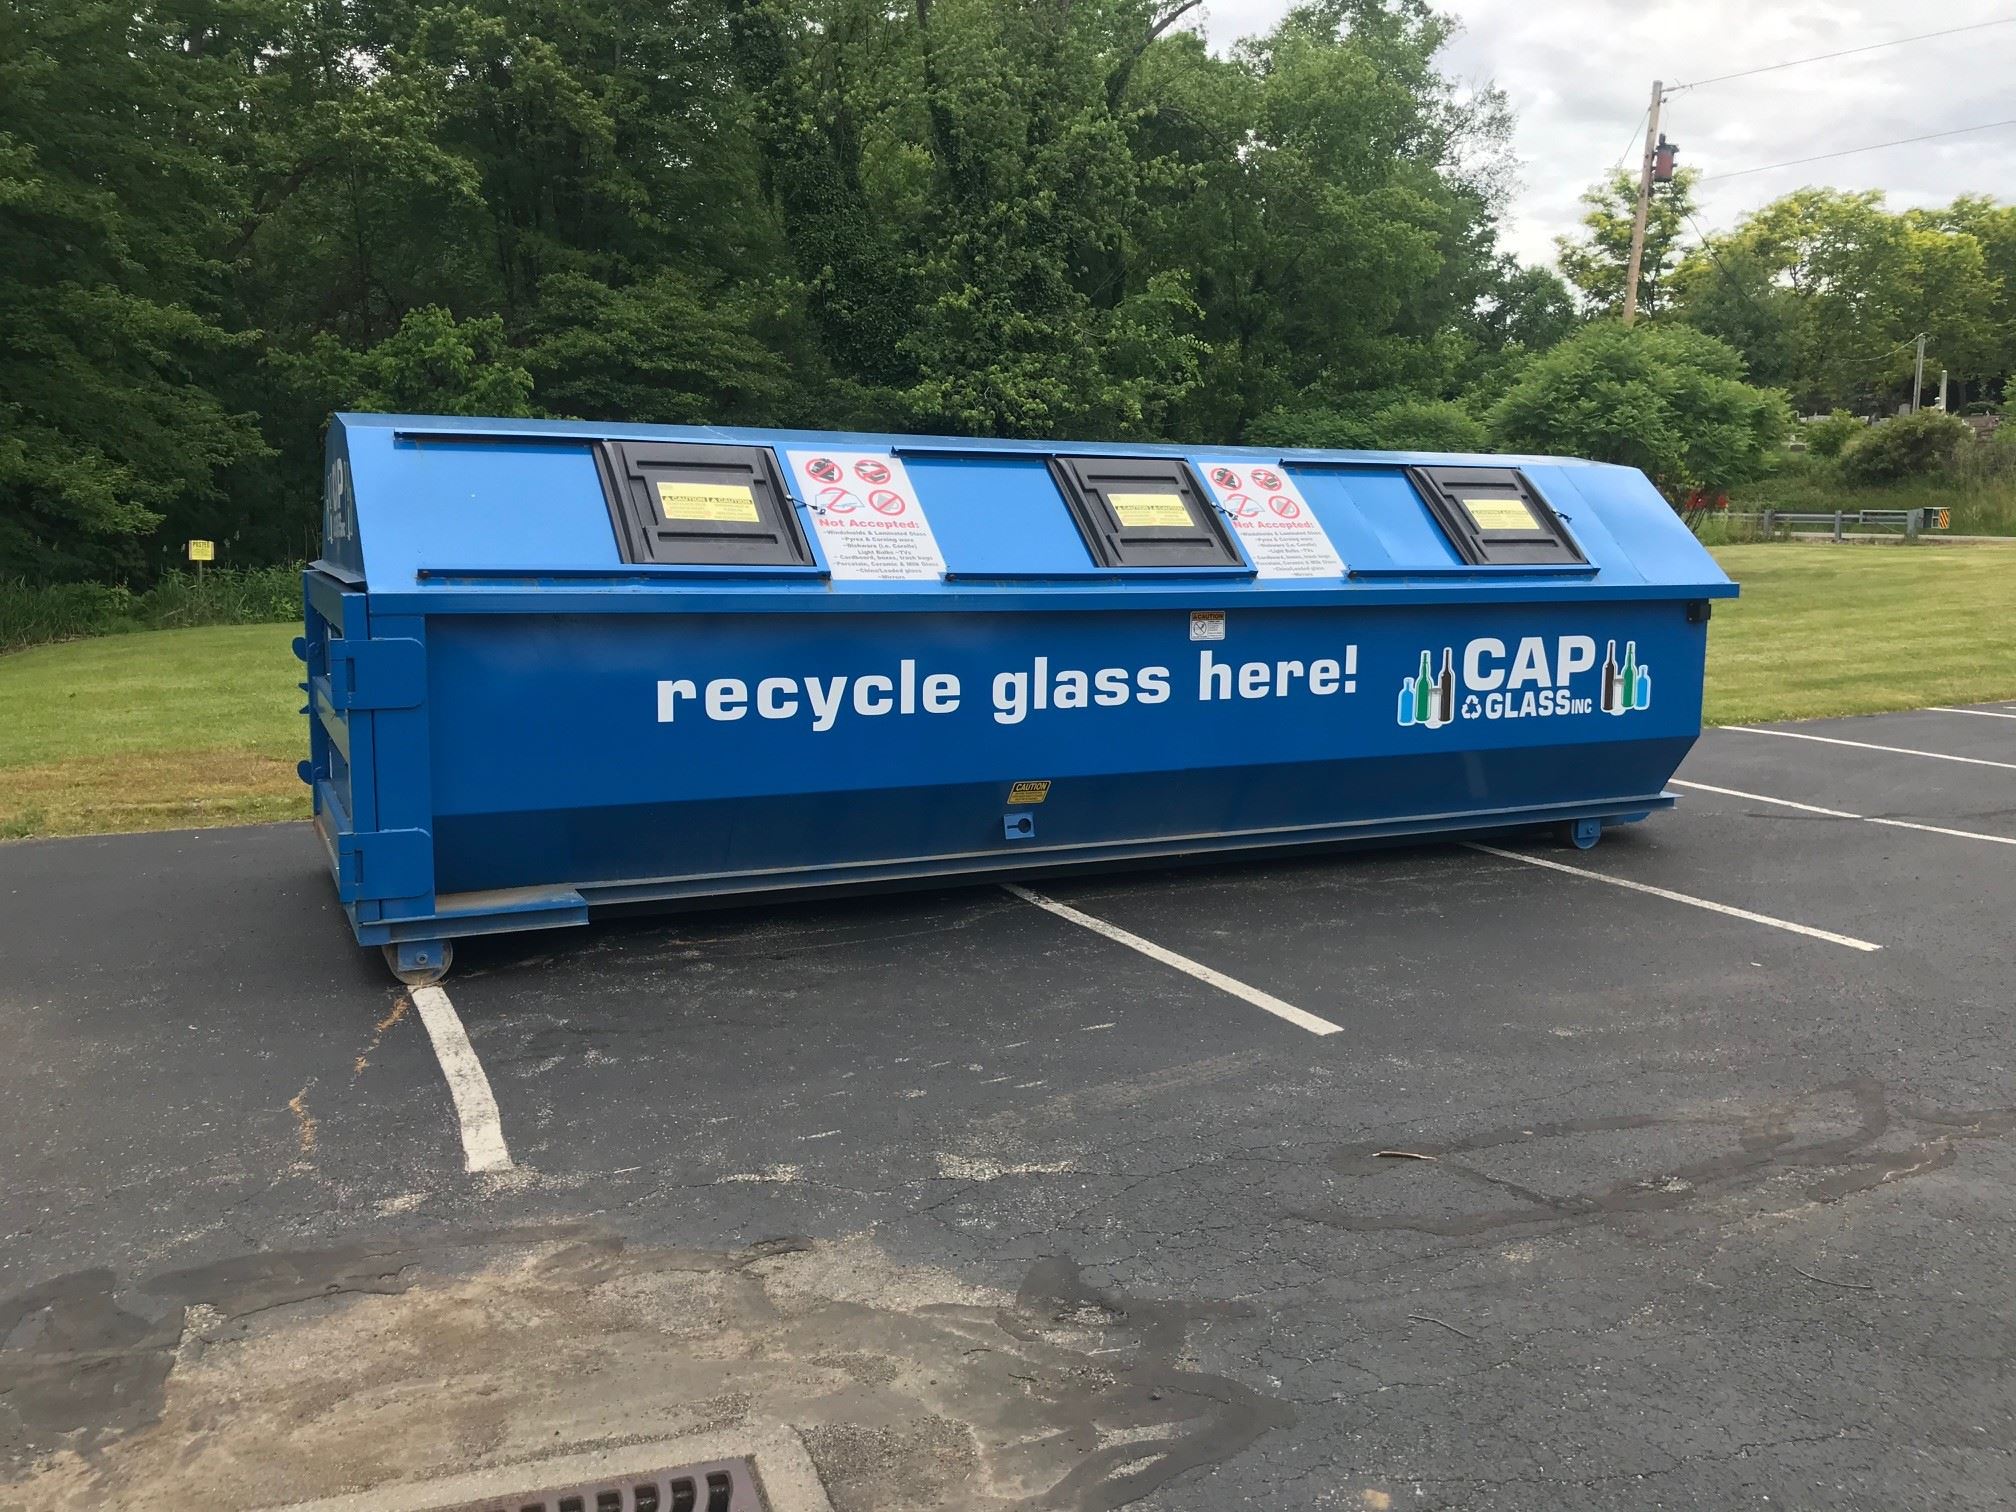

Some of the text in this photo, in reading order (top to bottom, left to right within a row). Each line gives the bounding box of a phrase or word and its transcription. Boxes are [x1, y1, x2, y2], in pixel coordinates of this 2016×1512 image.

[818, 519, 919, 529] Not Accepted:
[1257, 521, 1313, 529] Accepted:
[1463, 635, 1596, 691] CAP
[657, 645, 1358, 732] recycle glass here!
[1485, 689, 1592, 719] GLASS INC
[1016, 783, 1048, 791] CAUTION
